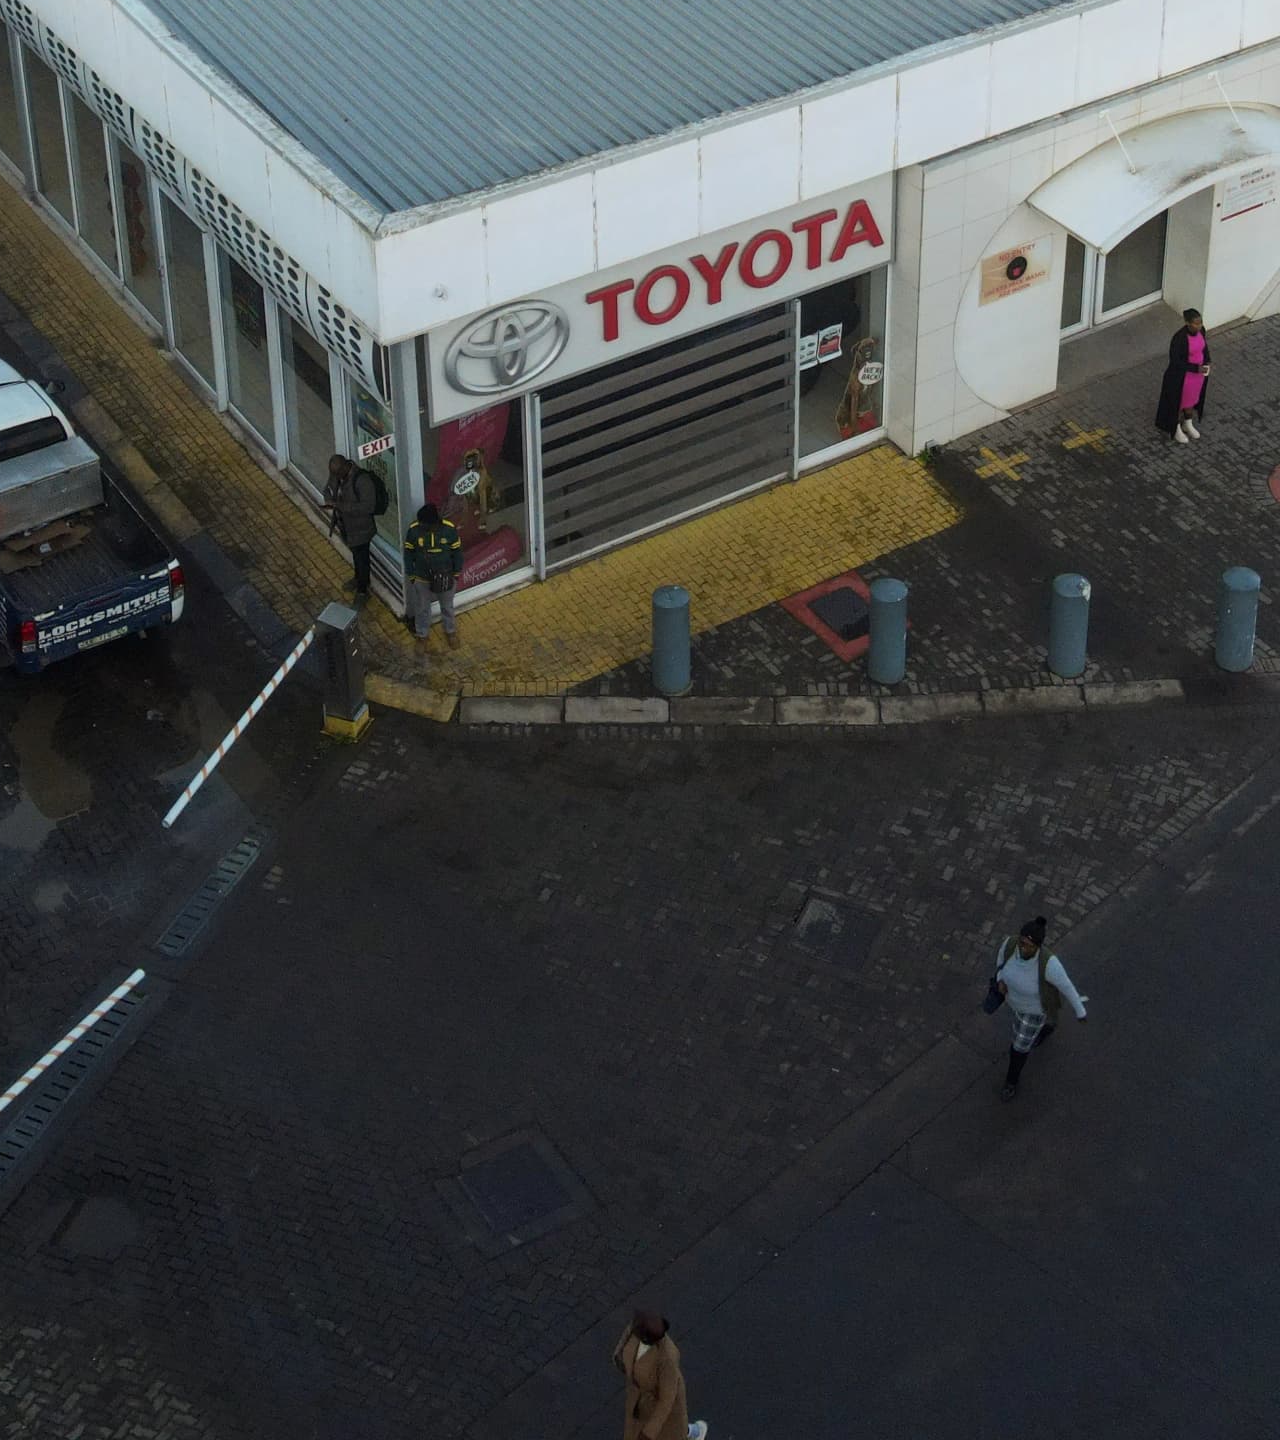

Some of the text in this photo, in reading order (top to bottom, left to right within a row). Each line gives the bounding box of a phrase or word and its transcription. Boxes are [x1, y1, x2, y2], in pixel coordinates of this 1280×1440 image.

[586, 198, 884, 343] TOYOTA
[362, 436, 392, 457] EXIT
[38, 585, 170, 641] LOCKSMITHS
